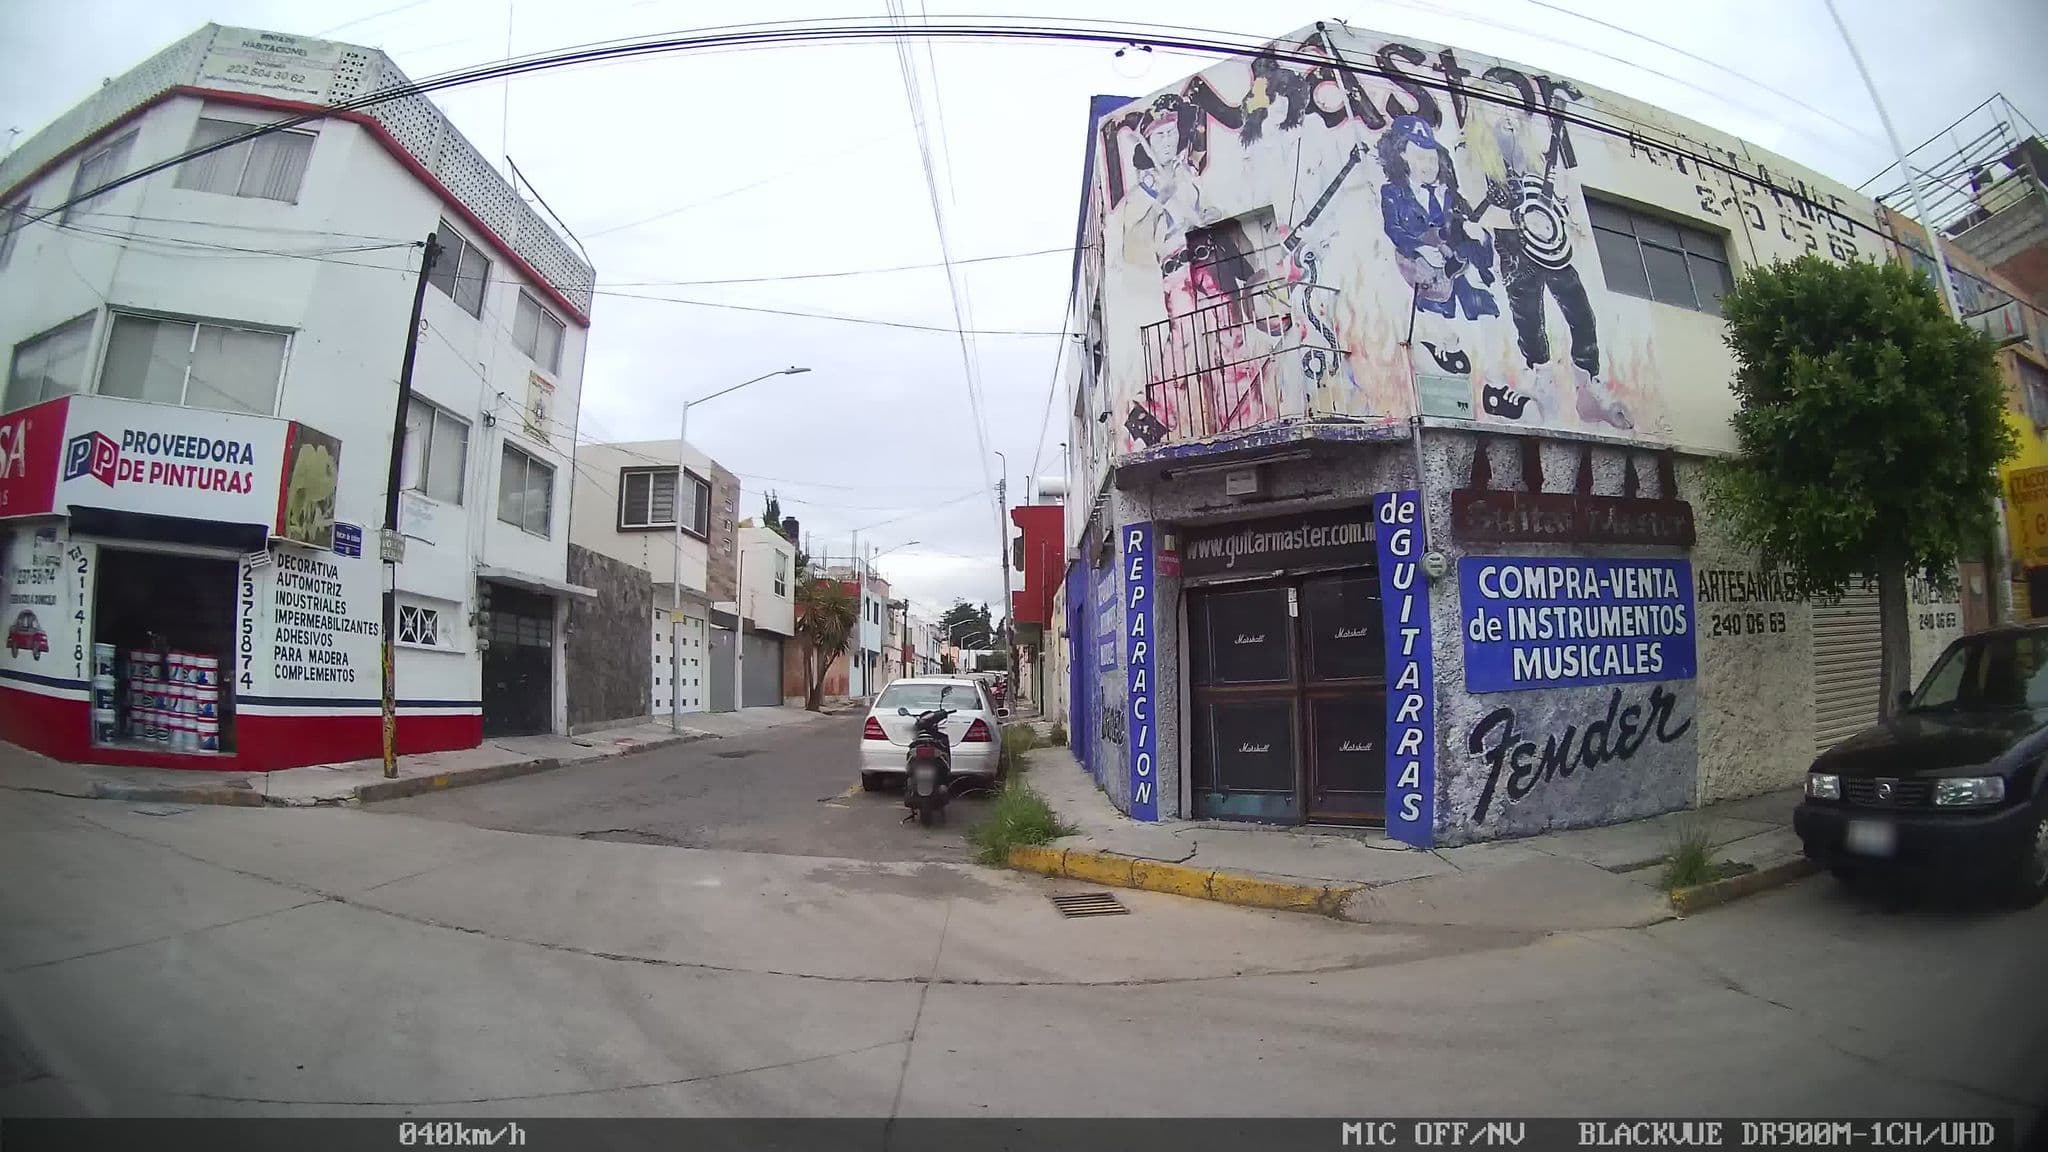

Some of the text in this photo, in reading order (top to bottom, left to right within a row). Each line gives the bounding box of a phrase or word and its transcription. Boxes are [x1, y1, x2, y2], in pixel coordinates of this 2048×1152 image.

[290, 73, 306, 84] 62
[121, 429, 254, 466] PROVEEDORA
[118, 458, 253, 495] DE PINTURAS
[1380, 493, 1416, 525] de
[277, 553, 339, 580] DECORATIVA
[276, 571, 342, 598] AUTOMOTRIZ
[1478, 565, 1680, 600] COMPRA-VENTA
[275, 590, 347, 615] INDUSTRIALES
[275, 608, 379, 636] IMPERMEABILIZANTES
[275, 627, 333, 647] ADHESIVOS
[1468, 604, 1687, 642] de INSTRUMENTOS
[1711, 612, 1786, 637] 240 06 63
[274, 645, 349, 667] PARA MADERA
[1127, 529, 1154, 805] REPARACION
[1513, 641, 1664, 682] MUSICALES
[274, 663, 355, 682] COMPLEMENTOS
[1390, 529, 1425, 822] GUITARRAS
[1467, 685, 1691, 826] Fender
